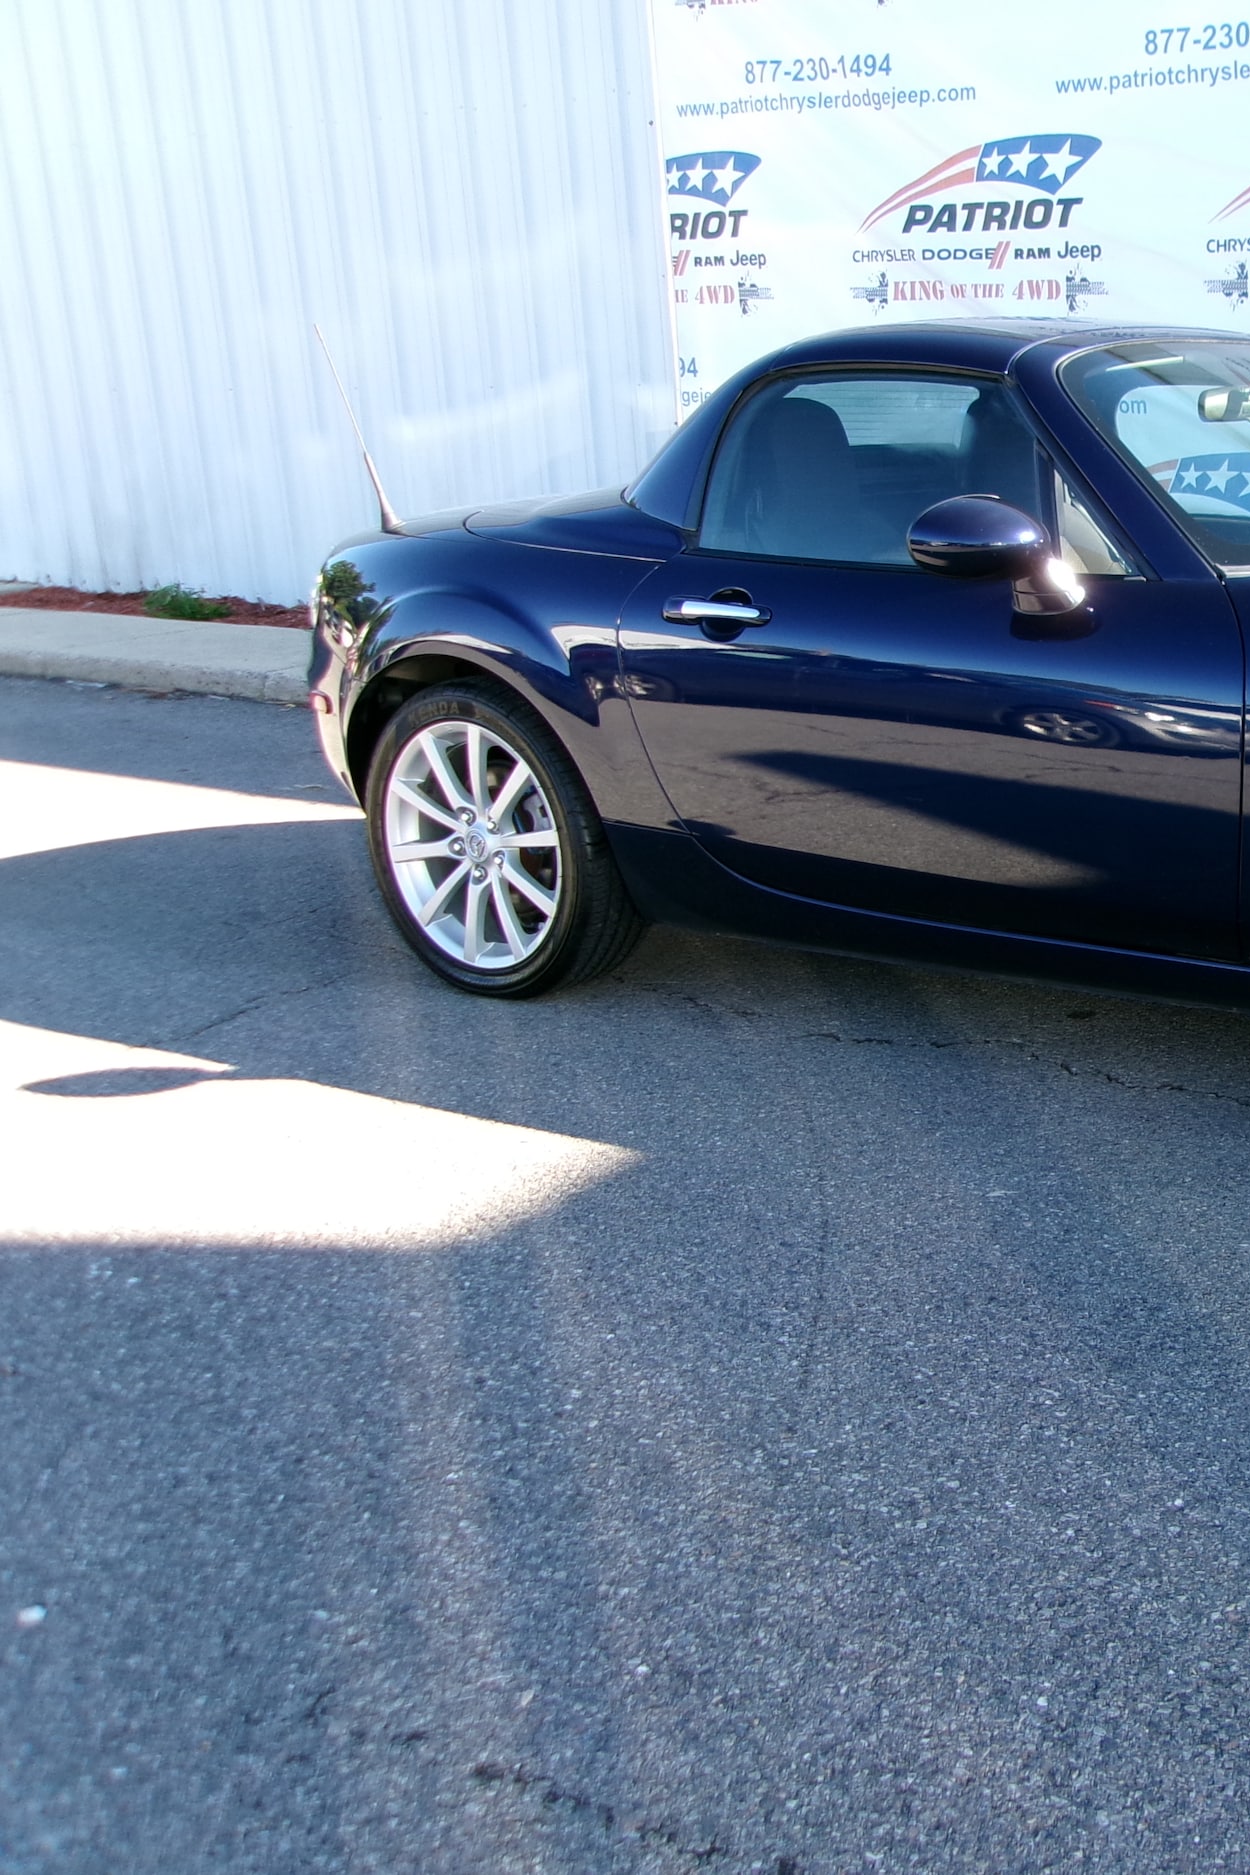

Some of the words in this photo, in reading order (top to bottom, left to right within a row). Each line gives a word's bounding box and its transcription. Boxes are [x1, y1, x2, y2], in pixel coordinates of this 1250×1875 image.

[744, 53, 893, 84] 877-230-1494
[676, 86, 976, 119] www.patriotchryslerdodgejeep.com
[902, 198, 1084, 233] PATRIOT
[694, 255, 725, 267] RAM
[730, 250, 767, 269] Jeep
[852, 249, 916, 263] CHRYSLER
[922, 248, 996, 261] DODGE
[1014, 247, 1051, 260] RAM
[1057, 241, 1102, 261] Jeep
[695, 285, 735, 304] 4WD
[893, 280, 944, 301] KING
[950, 283, 967, 298] OF
[971, 283, 1004, 298] THE
[1012, 279, 1061, 300] 4WD
